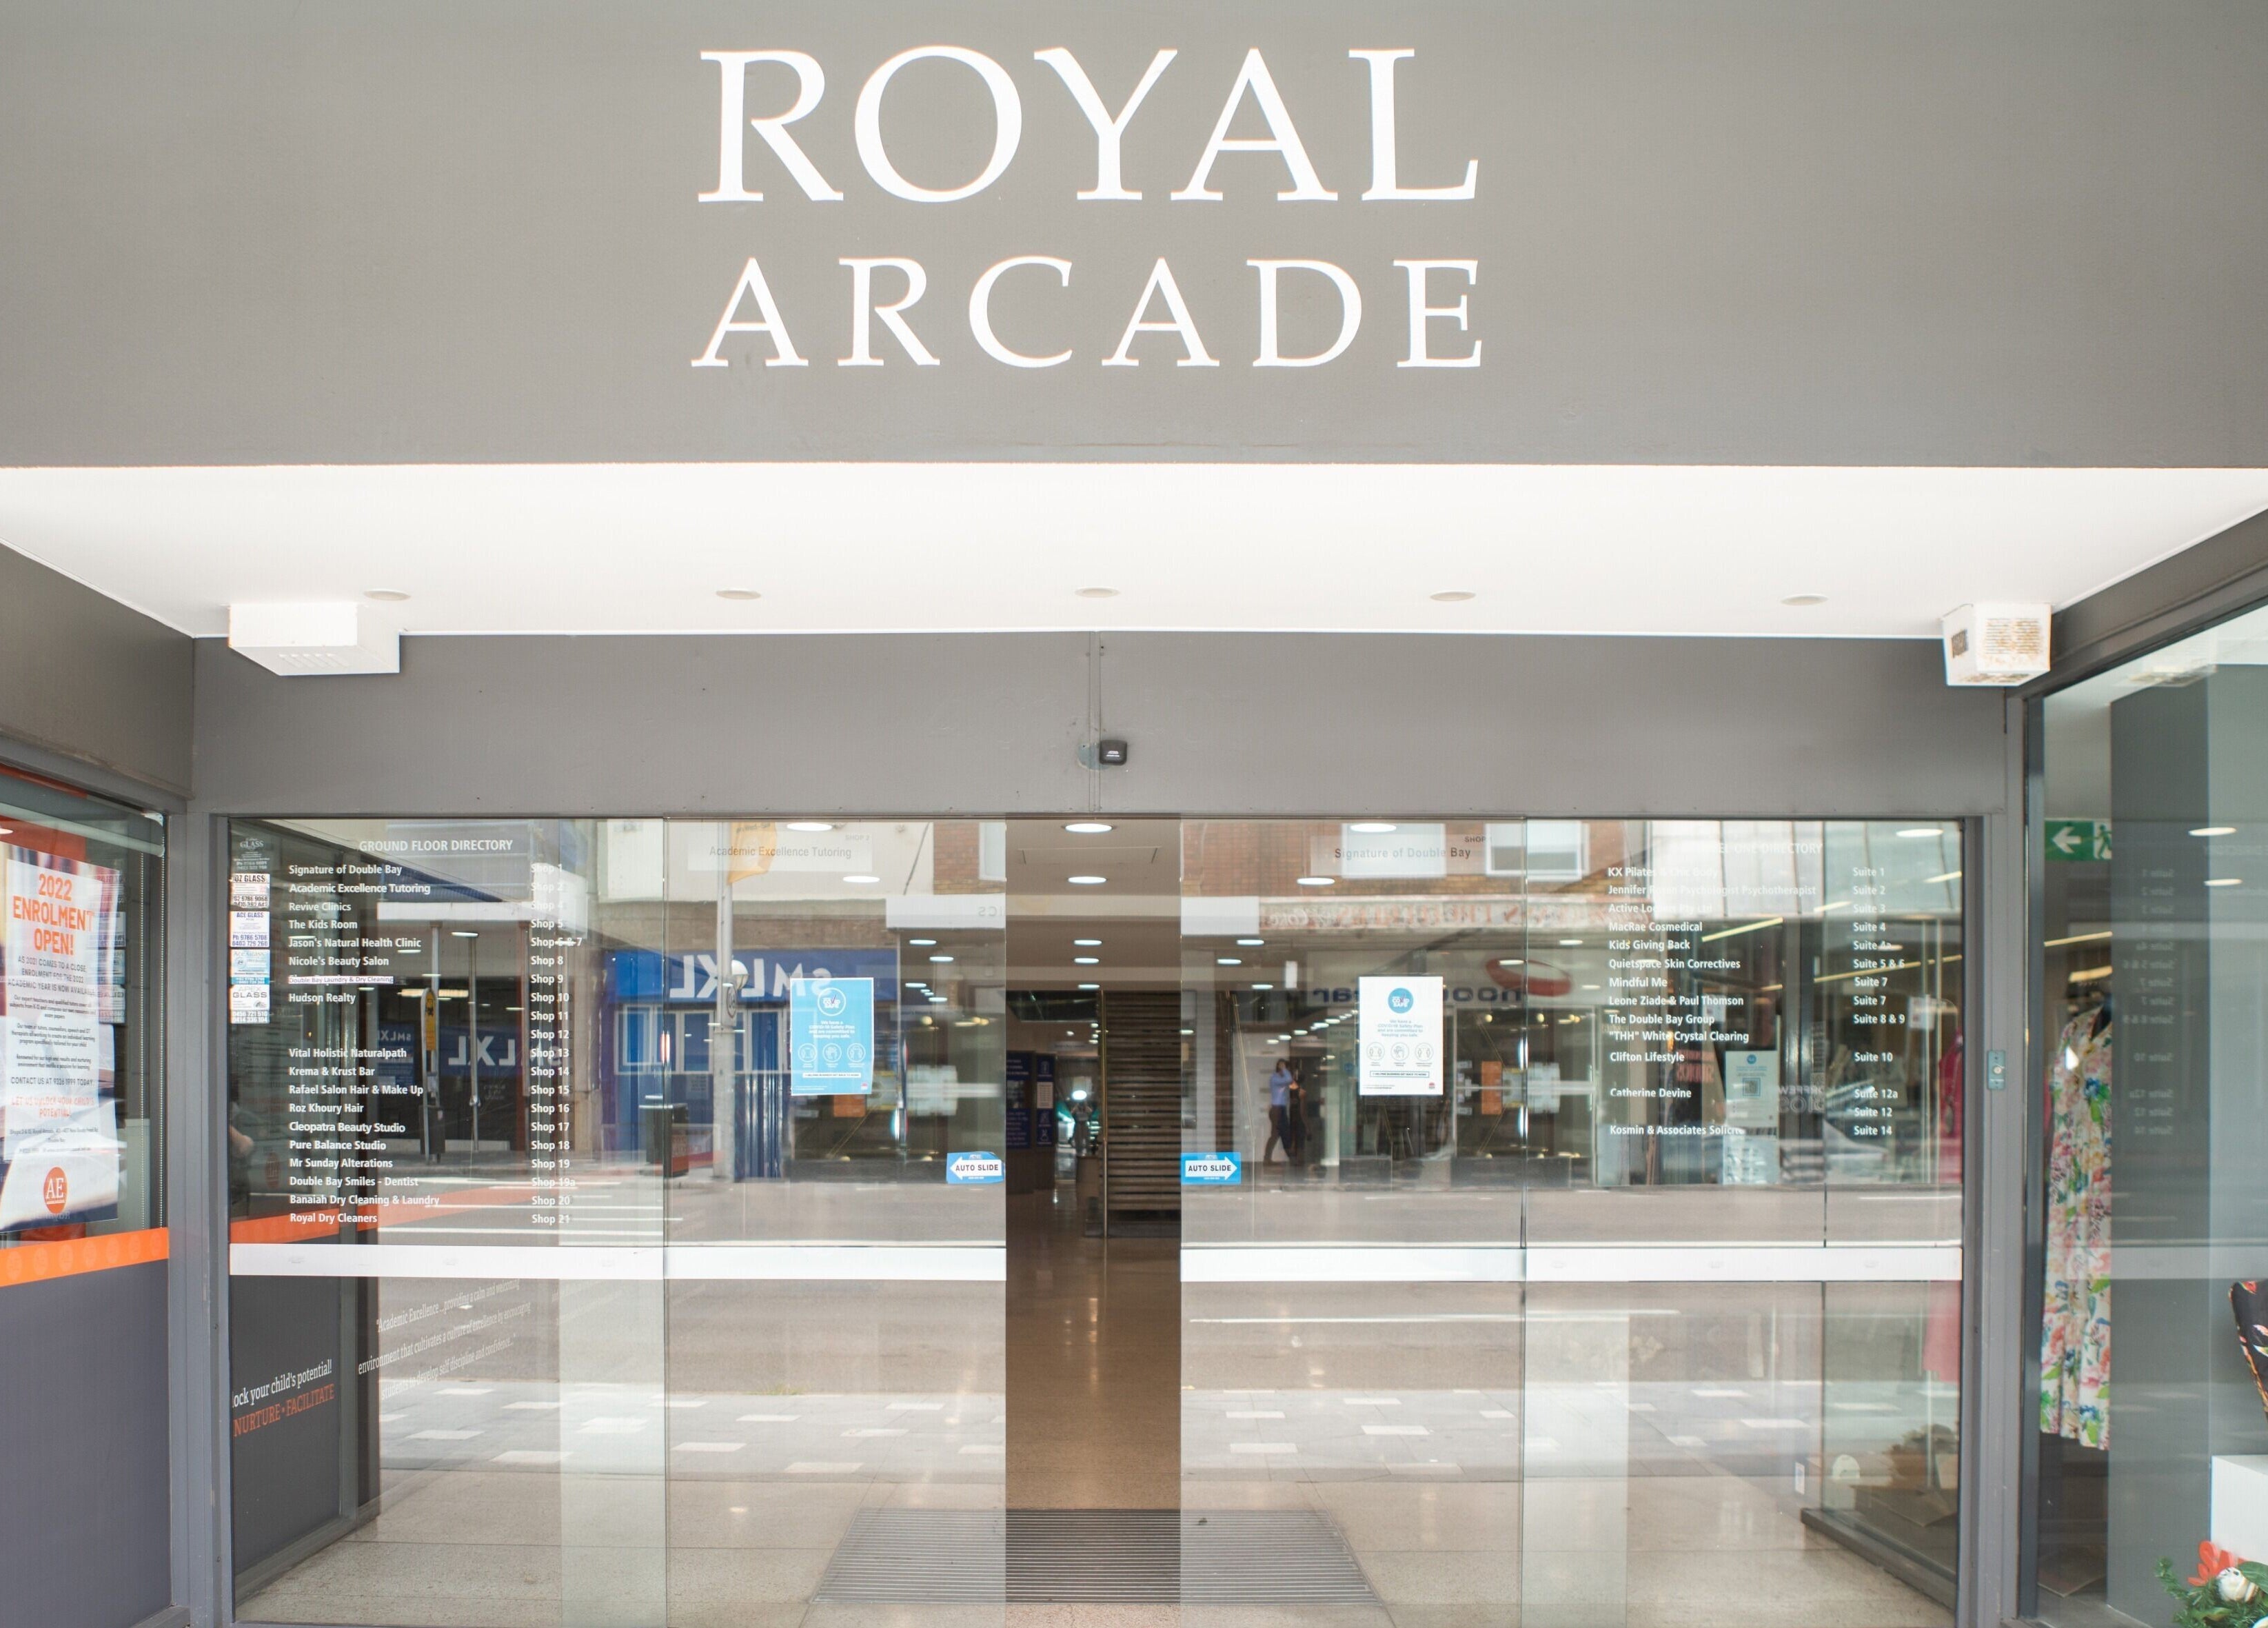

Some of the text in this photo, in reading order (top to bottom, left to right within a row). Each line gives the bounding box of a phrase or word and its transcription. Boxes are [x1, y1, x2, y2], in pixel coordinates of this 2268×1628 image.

[698, 45, 1478, 203] ROYAL
[691, 255, 1481, 368] ARCADE
[359, 840, 513, 852] GROUND FLOOR DIRECTORY
[709, 846, 851, 859] Academic Excellence Tutoring
[1335, 847, 1470, 860] Signature of Double Bay
[290, 865, 402, 876] Signature of Double Bay
[1608, 867, 1622, 876] KX
[39, 874, 72, 901] 2022
[290, 884, 430, 894] Academic Excellence Tutoring
[1608, 885, 1647, 894] Jennifer
[322, 902, 351, 911] Clinics
[1609, 904, 1638, 912] Active
[13, 896, 94, 931] ENROLMENT
[289, 920, 357, 929] The Kids Room
[1609, 922, 1702, 931] MacRae Cosmedical
[1854, 923, 1885, 932] Suite 4
[34, 929, 74, 955] OPEN!
[288, 938, 421, 947] Jason's Natural Health Clinic
[1610, 939, 1690, 951] Kids Giving Back
[289, 956, 389, 967] Nicole's Beauty Salon
[531, 956, 563, 965] Shop 8
[1610, 958, 1741, 970] Quietspace Skin Correctives
[1610, 977, 1668, 987] Mindful Me
[289, 993, 355, 1003] Hudson Realty
[1610, 996, 1743, 1005] Leone Ziade & Paul Thomson
[1854, 996, 1886, 1005] Suite 7
[1610, 1014, 1714, 1026] The Double Bay Group
[1674, 1031, 1707, 1043] Crystal
[1710, 1032, 1749, 1043] Clearing
[290, 1048, 407, 1059] Vital Holistic Naturalpath
[1610, 1052, 1642, 1061] Clifton
[1646, 1052, 1685, 1063] Lifestyle
[1854, 1052, 1892, 1062] Suite 10
[290, 1067, 375, 1076] Krema & Krust Bar
[290, 1085, 423, 1096] Rafael Salon Hair & Make Up
[531, 1085, 569, 1096] Shop 15
[1610, 1088, 1692, 1098] Catherine Devine
[290, 1103, 363, 1114] Roz Khoury Hair
[290, 1121, 405, 1134] Cleopatra Beauty Studio
[531, 1123, 569, 1132] Shop 17
[1610, 1125, 1706, 1135] Kosmin & Associates
[1854, 1125, 1892, 1135] Suite 14
[290, 1140, 386, 1149] Pure Balance Studio
[290, 1158, 392, 1169] Mr Sunday Alterations
[290, 1177, 323, 1185] Double
[326, 1177, 342, 1187] Bay
[345, 1177, 375, 1185] Smiles
[385, 1177, 418, 1186] Dentist
[46, 1177, 64, 1199] AE
[290, 1195, 439, 1206] Banaiah Dry Cleaning & Laundry
[290, 1213, 377, 1224] Royal Dry Cleaners
[409, 1303, 438, 1323] Excellence
[358, 1334, 441, 1374] environment that cultivates
[250, 1384, 270, 1405] your
[272, 1372, 296, 1394] child's
[298, 1359, 332, 1389] potential!
[234, 1383, 334, 1437] NURTURE FACILITATE
